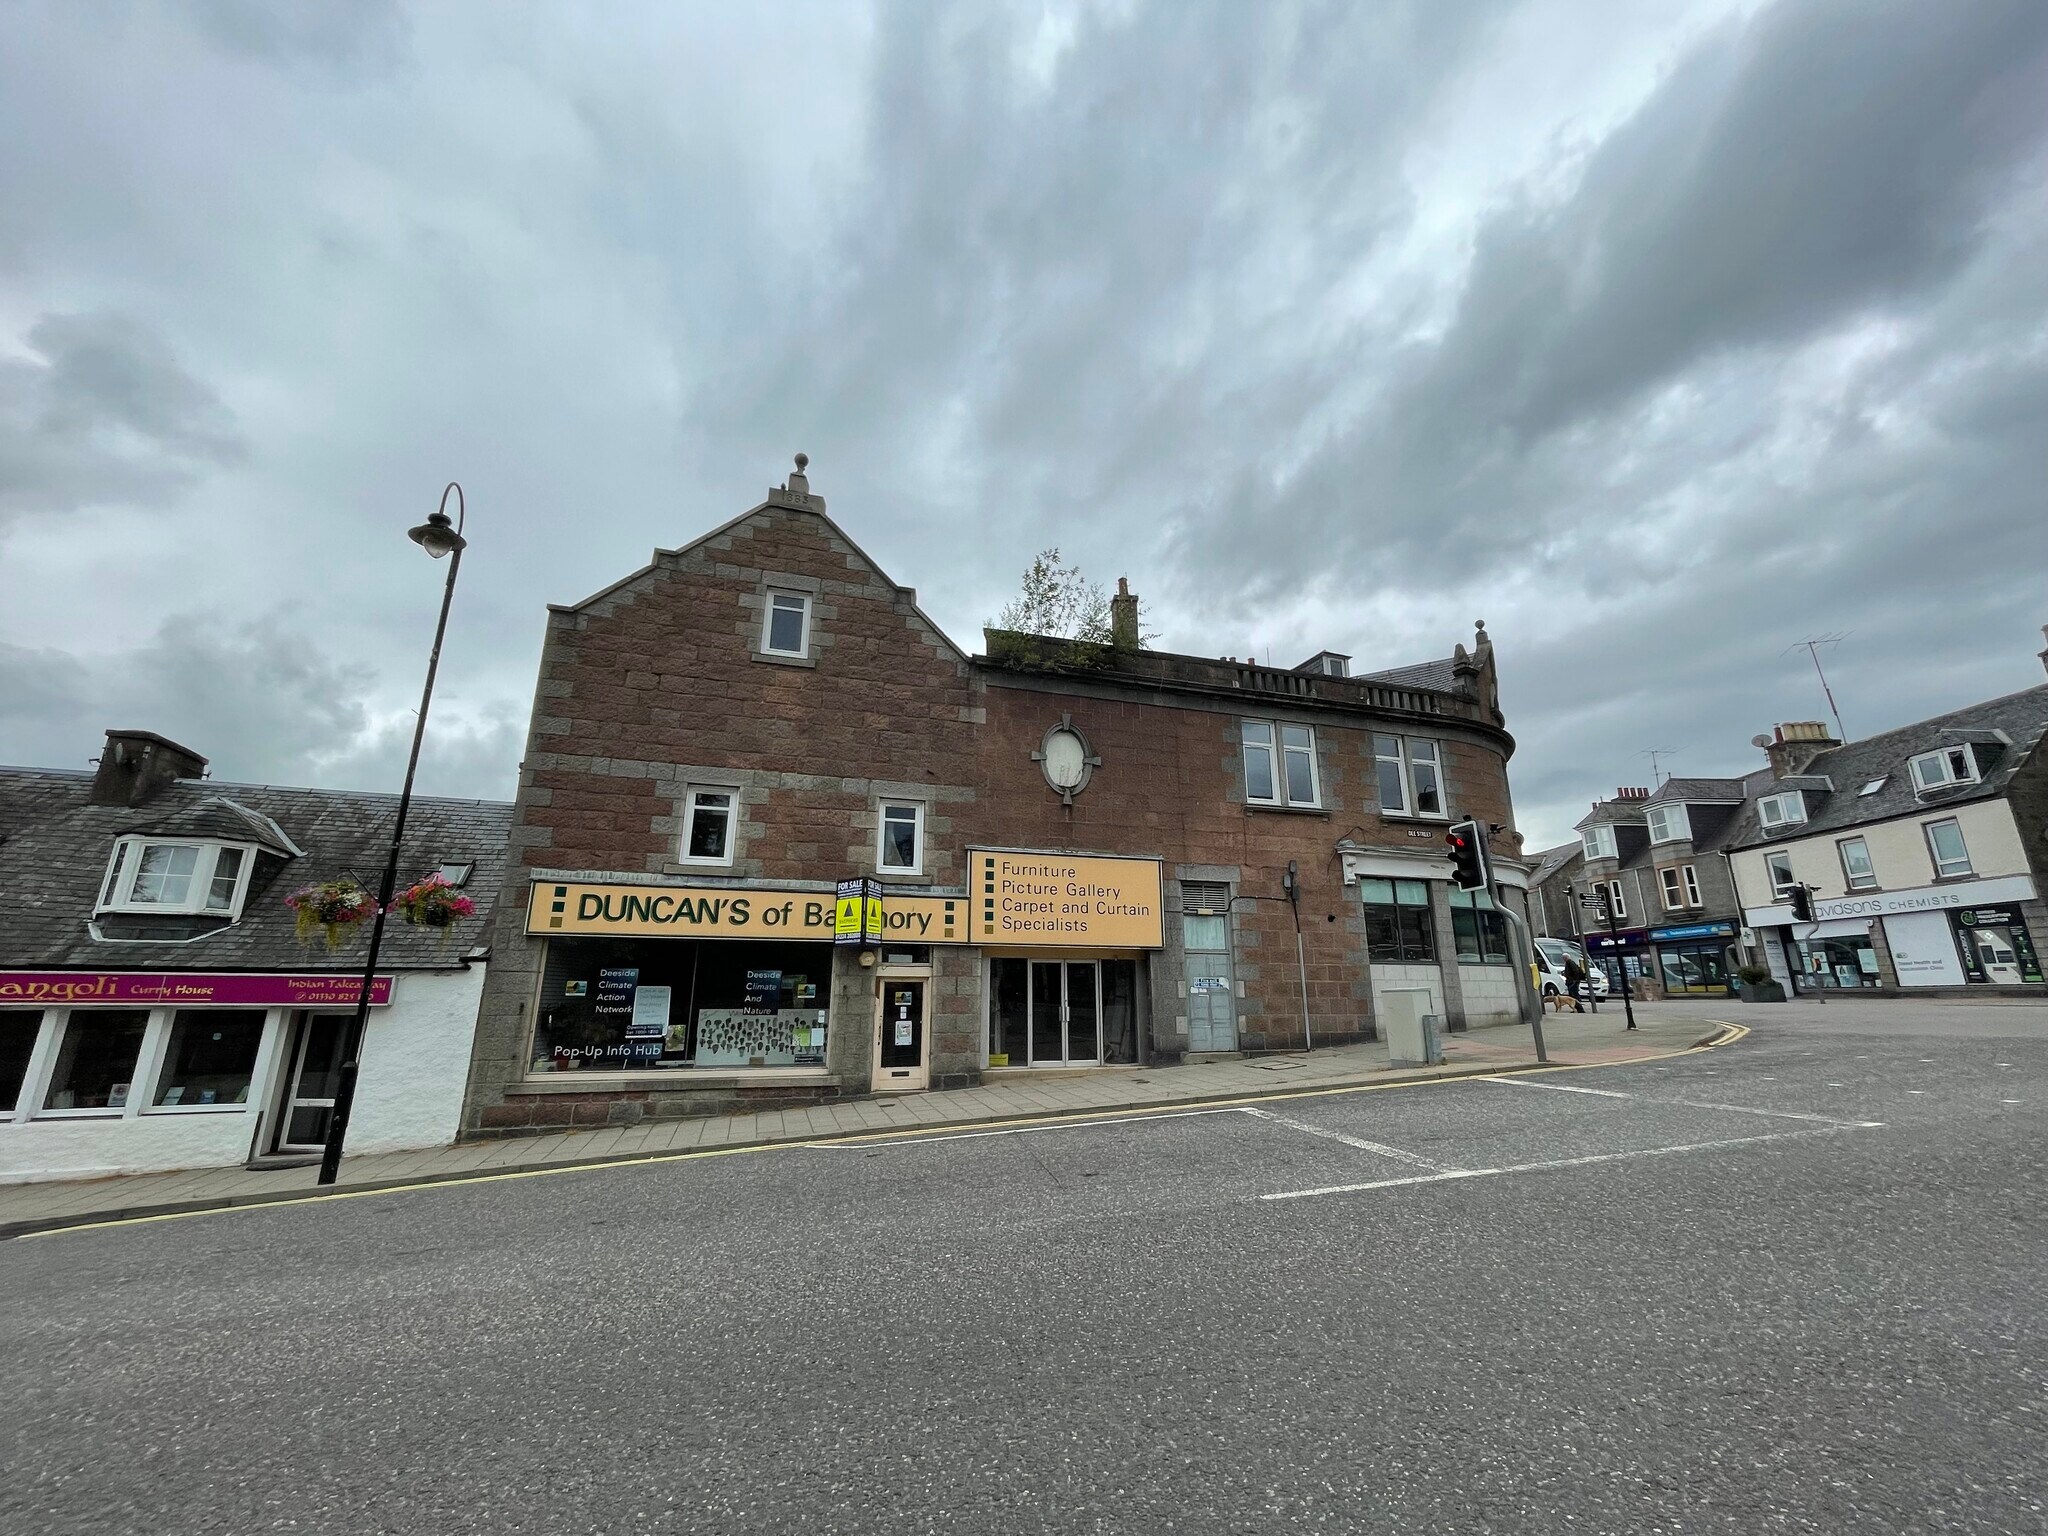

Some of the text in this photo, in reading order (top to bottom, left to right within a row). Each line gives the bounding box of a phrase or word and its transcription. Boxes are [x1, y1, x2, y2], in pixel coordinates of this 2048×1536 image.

[782, 491, 809, 504] 1883
[1002, 861, 1076, 878] Furniture
[837, 879, 863, 891] FOR SALE
[1002, 880, 1121, 900] Picture Gallery
[1002, 897, 1150, 916] Carpet and Curtain
[1815, 894, 1960, 918] avidsons CHEMISTS
[577, 893, 932, 936] DUNCAN'S of Baory
[1002, 915, 1088, 933] Specialists
[600, 969, 636, 977] Deeside
[747, 970, 782, 979] Deeside
[0, 976, 214, 1001] angoli Curry House
[288, 979, 387, 991] Indian Takeaay
[598, 981, 633, 989] Climate
[745, 982, 777, 991] Climate
[596, 993, 626, 1001] Action
[744, 994, 763, 1003] And
[595, 1005, 633, 1013] Network
[743, 1007, 772, 1015] Nature
[554, 1044, 662, 1059] Pop-Up Info Hub
